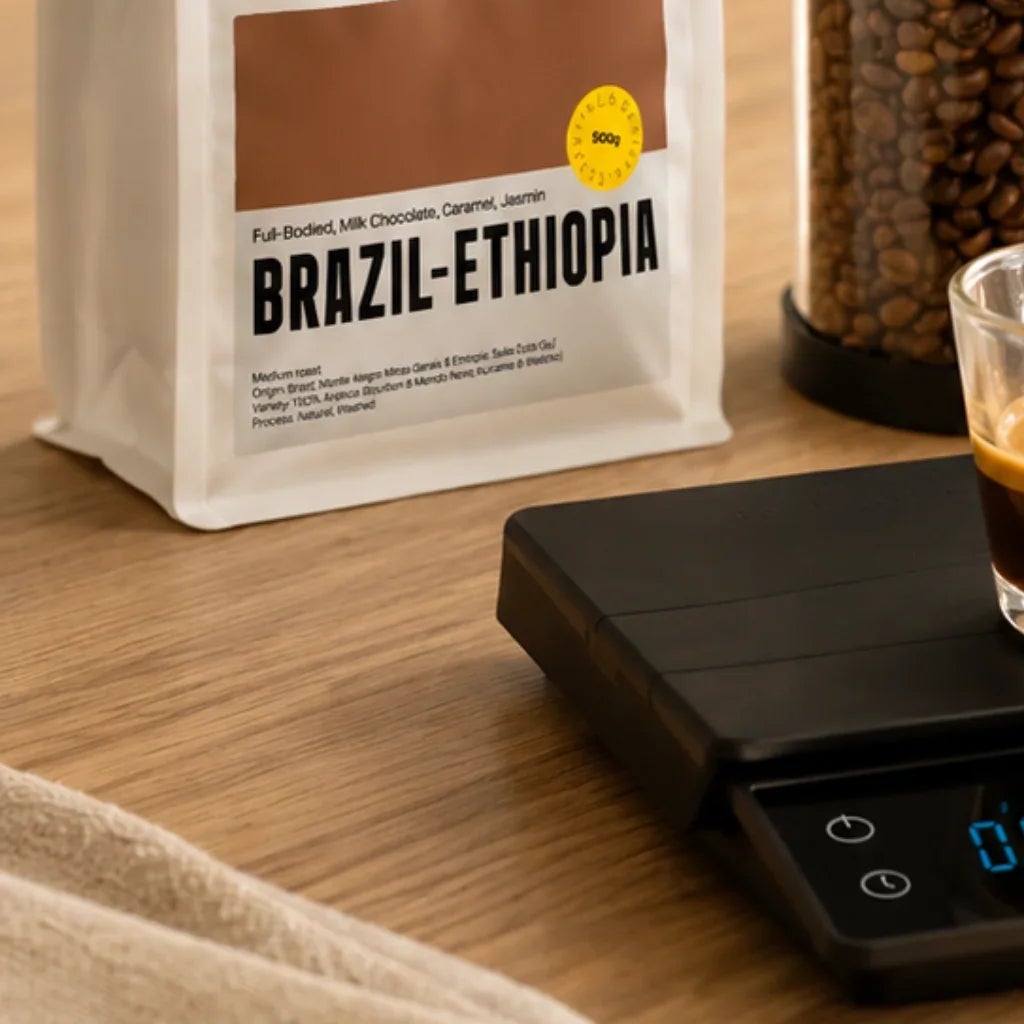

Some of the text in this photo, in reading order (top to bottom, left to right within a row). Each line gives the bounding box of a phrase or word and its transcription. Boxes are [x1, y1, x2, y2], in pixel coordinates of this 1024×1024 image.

[252, 188, 546, 243] Full-Bodied, Milk Chocolate, Caramel, Jasmin
[252, 197, 659, 336] BRAZIL-ETHIOPIA
